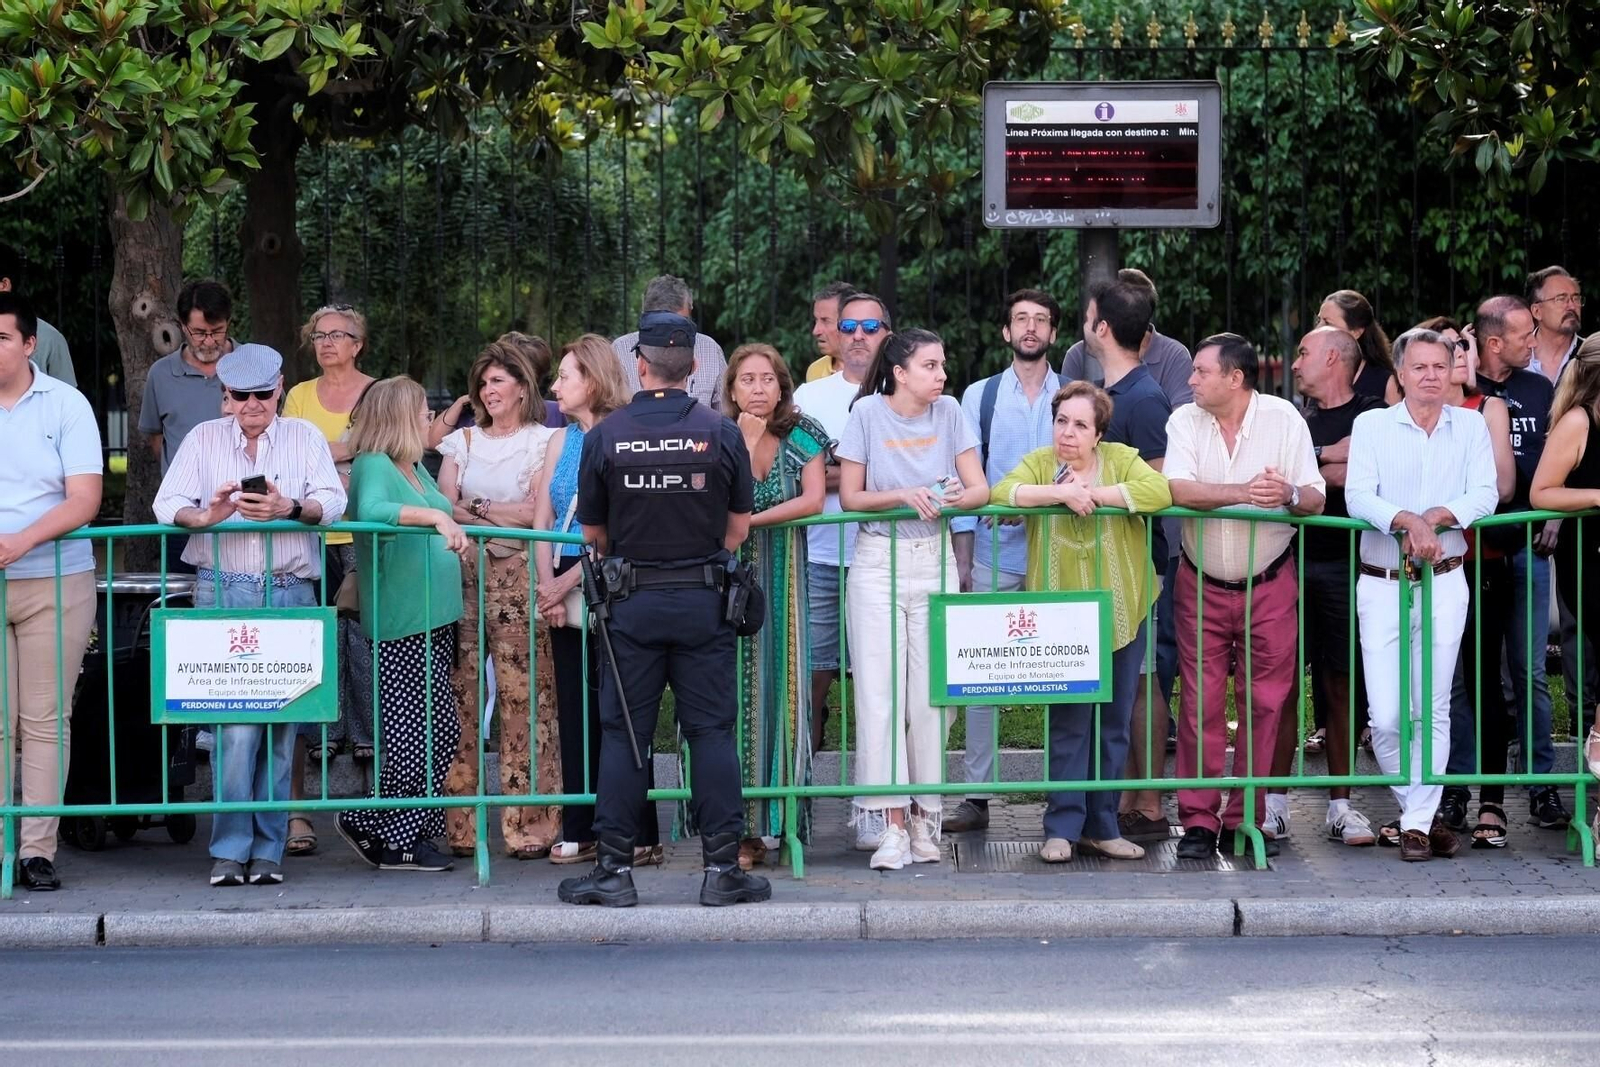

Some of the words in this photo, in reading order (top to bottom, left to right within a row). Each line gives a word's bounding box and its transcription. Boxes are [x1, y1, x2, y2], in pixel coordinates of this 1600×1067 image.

[1005, 128, 1028, 137] Línea
[1031, 128, 1068, 137] Próxima
[1071, 128, 1103, 139] llegada
[1125, 128, 1158, 137] destino
[1179, 128, 1198, 136] Min.
[1512, 417, 1536, 432] ETT
[616, 438, 696, 454] POLICIA
[624, 474, 688, 488] U.I.P.
[958, 646, 1028, 658] AYUNTAMIENTO
[1030, 646, 1042, 656] DE
[1044, 643, 1090, 656] CÓRDOBA
[178, 663, 249, 673] AYUNTAMIENTO
[252, 663, 264, 673] DE
[266, 660, 313, 673] CÓRDOBA
[968, 661, 991, 670] Área
[994, 661, 1006, 669] de
[1010, 660, 1085, 669] Infraestructuras
[188, 675, 212, 686] Área
[214, 677, 227, 686] de
[231, 677, 307, 686] Infraestructuras
[988, 672, 1015, 681] Equipo
[1030, 672, 1064, 680] Montajes
[209, 689, 236, 698] Equipo
[251, 689, 286, 698] Montajes
[962, 685, 1005, 693] PERDONEN
[1024, 684, 1068, 692] MOLESTIAS
